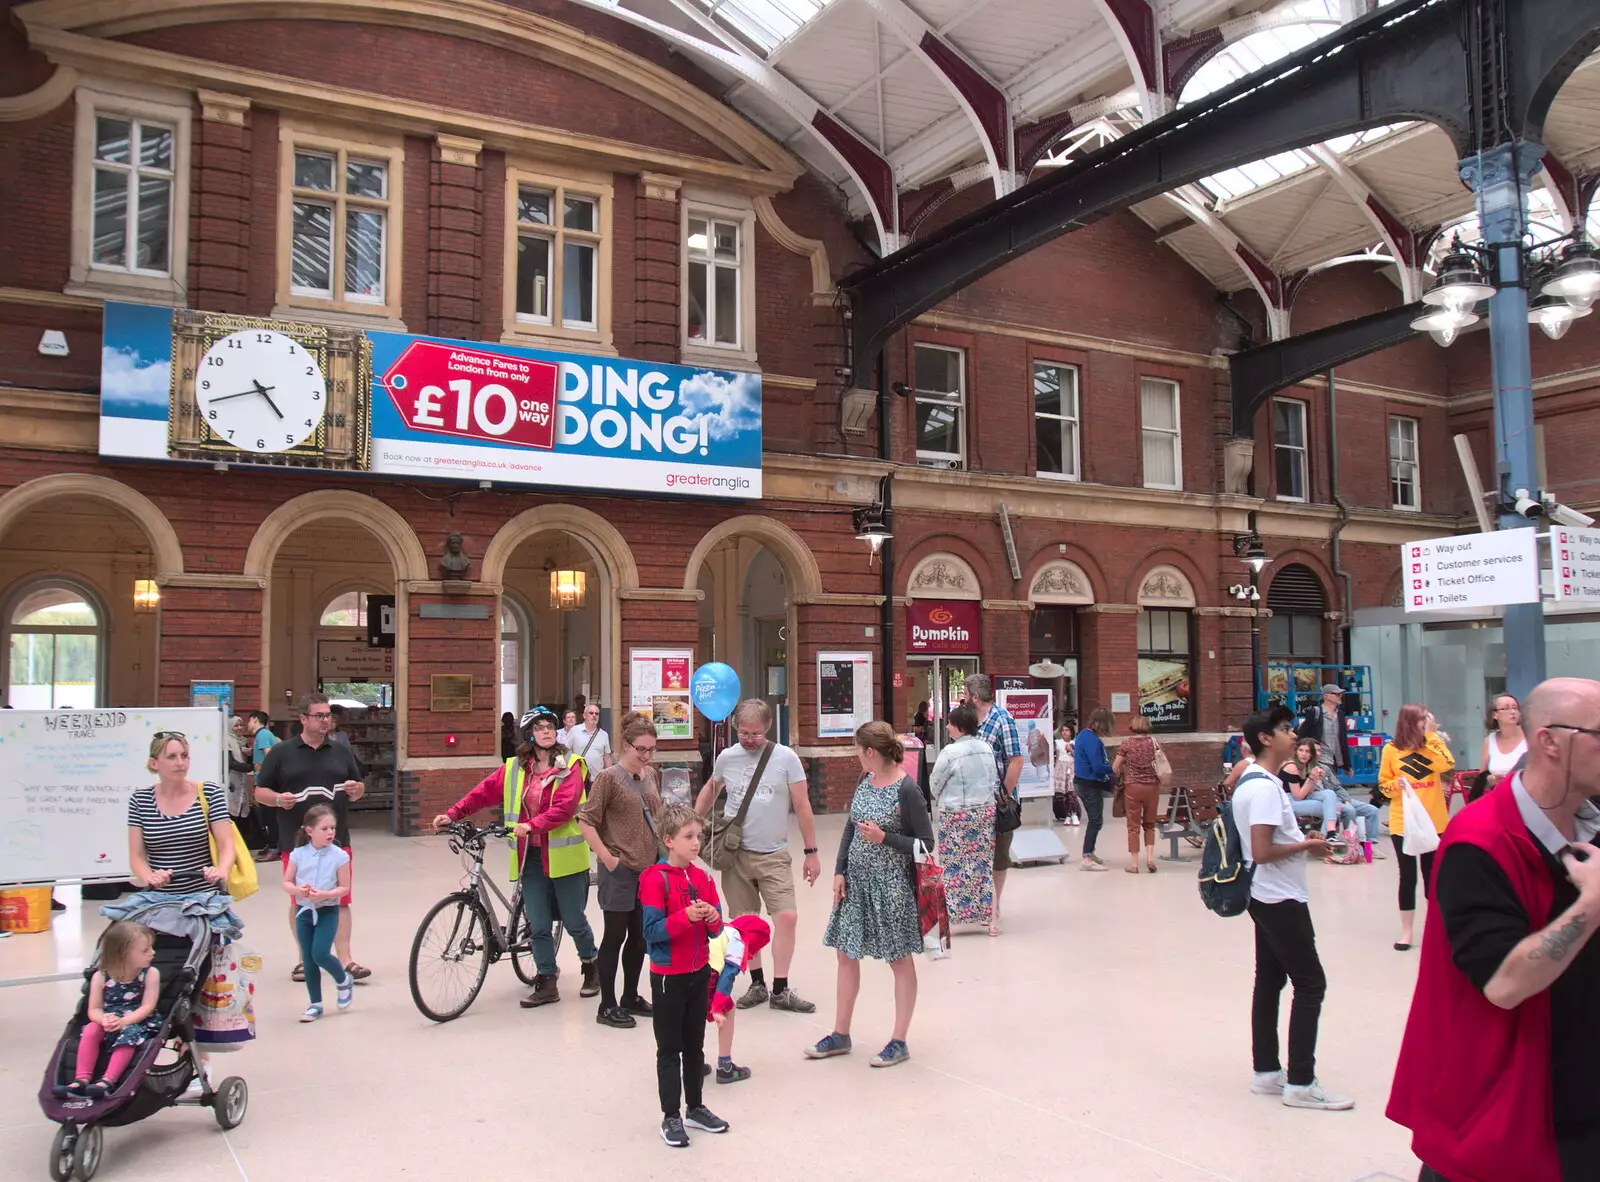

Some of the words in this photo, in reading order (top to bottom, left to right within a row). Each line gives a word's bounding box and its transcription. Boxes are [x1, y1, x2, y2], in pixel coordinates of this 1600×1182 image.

[227, 338, 243, 350] 11
[256, 333, 272, 344] 12
[288, 345, 296, 355] 1
[207, 356, 224, 367] 10
[450, 352, 491, 366] Advance
[493, 359, 518, 371] Fares
[519, 364, 530, 372] to
[305, 366, 314, 376] 2
[448, 361, 484, 375] London
[486, 368, 508, 378] from
[510, 373, 530, 384] only
[201, 380, 210, 390] 9
[560, 362, 675, 412] DING
[312, 390, 321, 401] 3
[412, 378, 518, 436] £10
[520, 399, 550, 412] one
[208, 410, 218, 420] 8
[519, 410, 550, 426] way
[304, 418, 313, 428] 4
[227, 430, 236, 440] 7
[559, 404, 708, 456] DONG!
[256, 438, 265, 449] 6
[286, 434, 294, 444] 5
[384, 452, 402, 461] Book
[434, 456, 542, 472] greateranglia.co.uk/advance
[666, 472, 750, 490] greateranglia
[1578, 534, 1592, 546] Way
[1436, 545, 1455, 555] Way
[1456, 542, 1472, 551] out
[1436, 558, 1480, 570] Customer
[1483, 554, 1523, 566] services
[1580, 552, 1600, 561] Custo
[1580, 569, 1600, 578] Ticke
[1438, 575, 1466, 587] Ticket
[1468, 574, 1495, 584] Office
[1438, 592, 1468, 604] Toilets
[912, 626, 968, 640] Pumpkin
[699, 690, 715, 701] Hut
[44, 712, 127, 732] WEEKEND
[68, 730, 96, 739] TRAVEL
